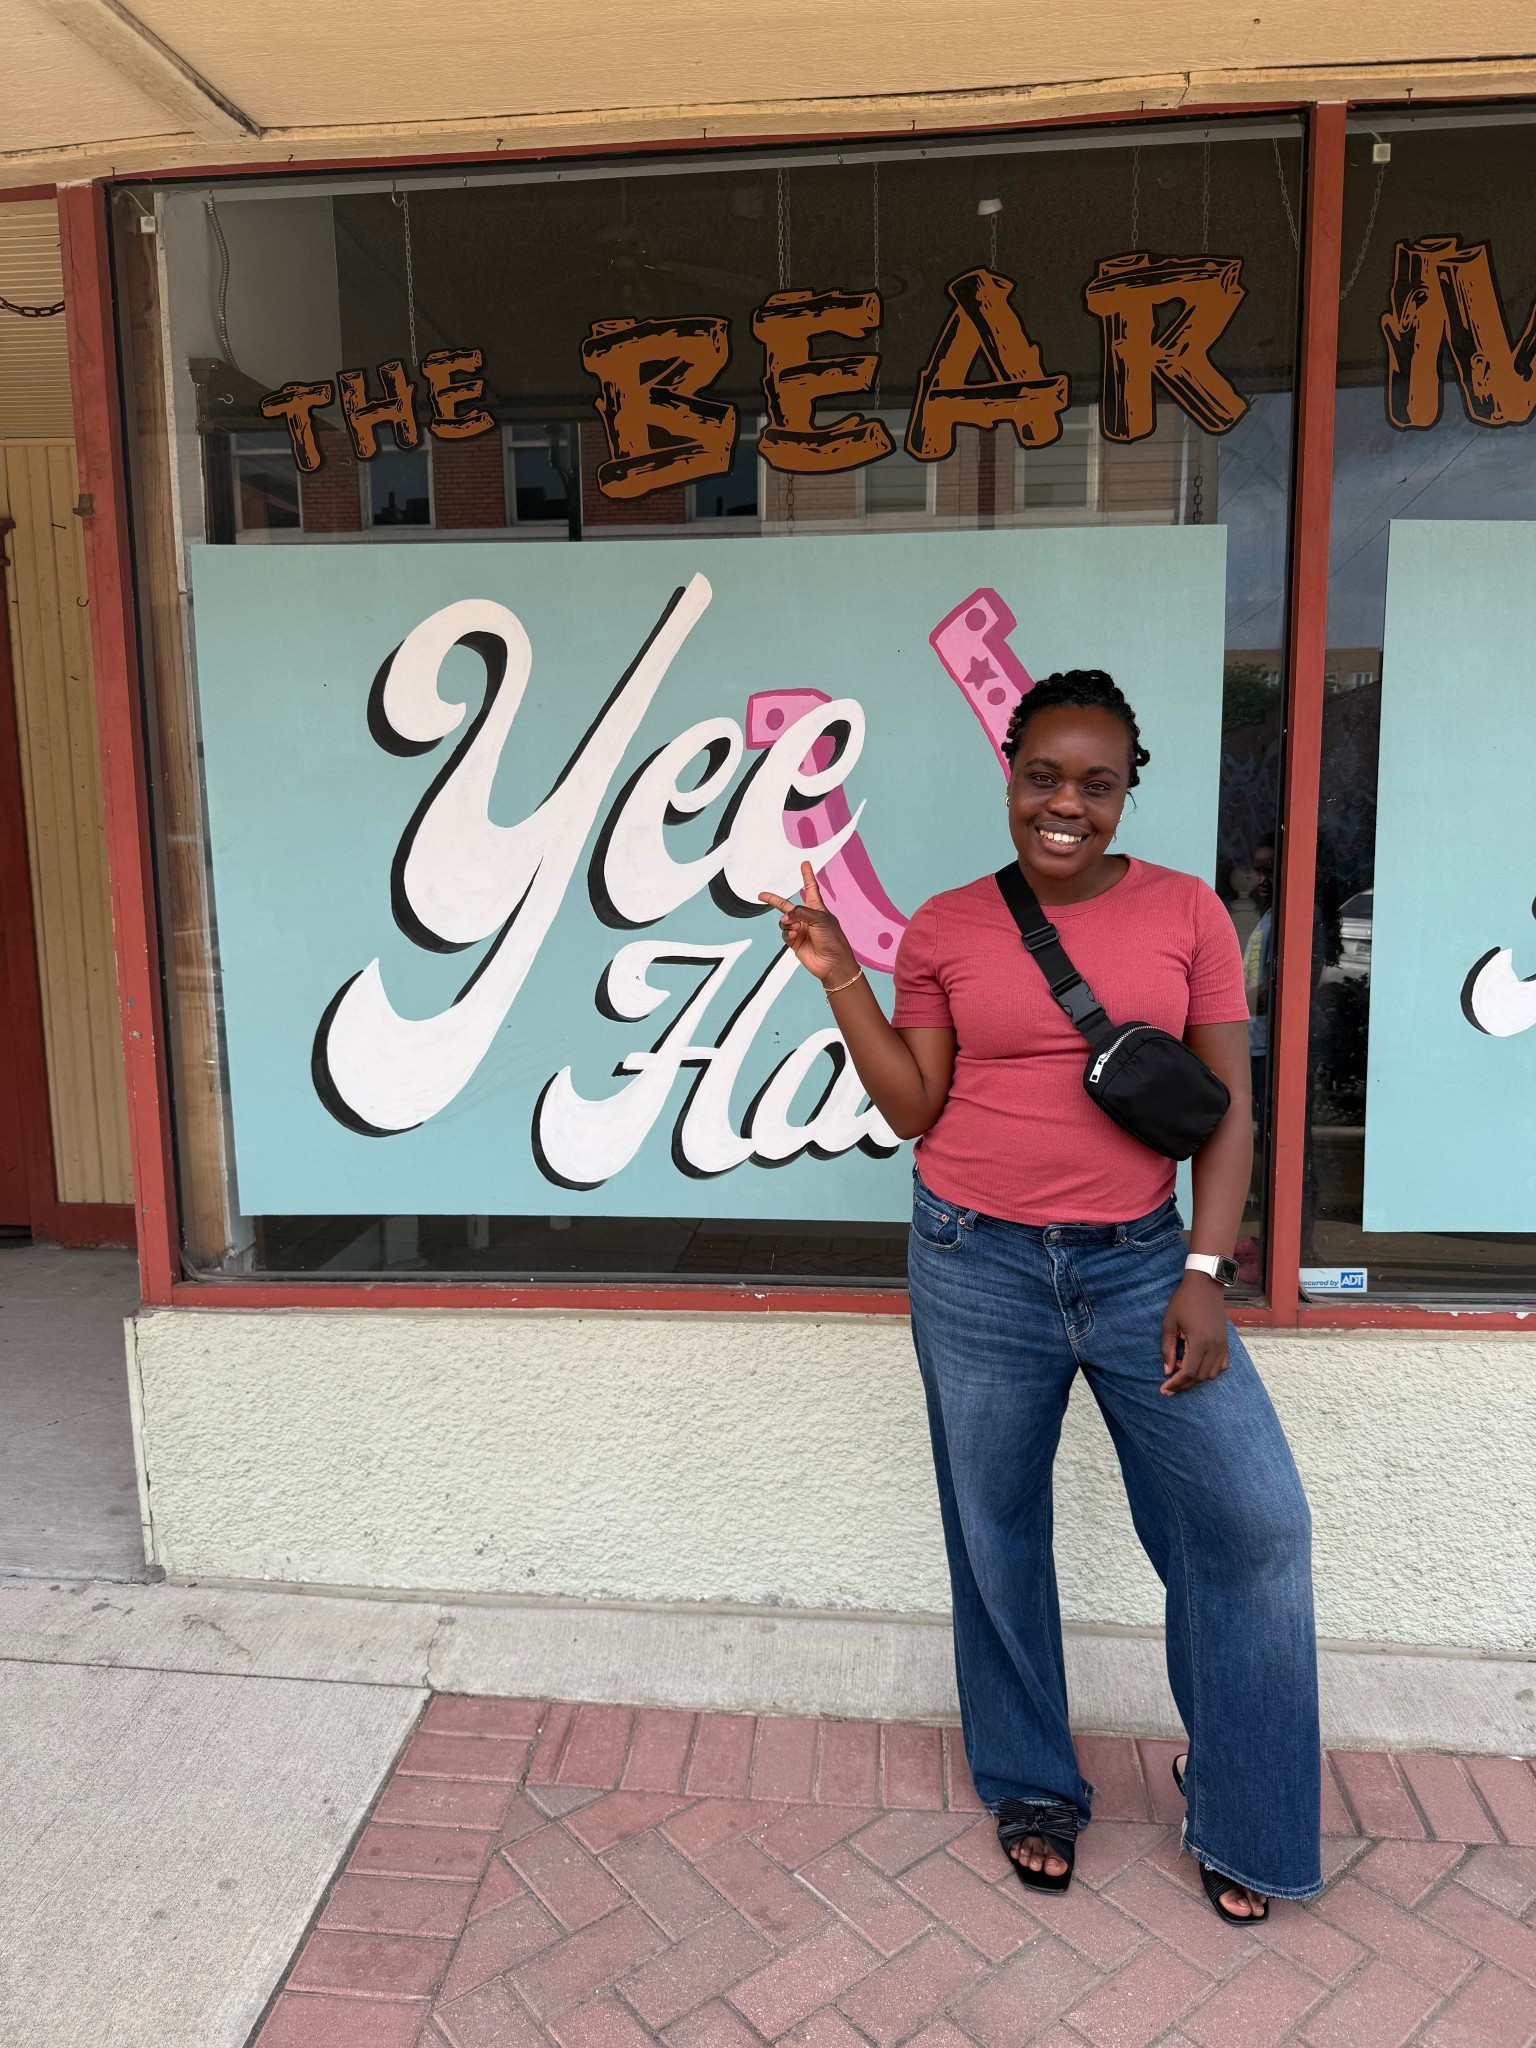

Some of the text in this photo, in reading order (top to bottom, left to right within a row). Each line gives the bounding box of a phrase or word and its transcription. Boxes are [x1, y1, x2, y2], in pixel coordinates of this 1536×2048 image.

[259, 347, 496, 474] THE
[578, 249, 1252, 502] BEAR
[311, 571, 867, 1138] Yee
[531, 938, 921, 1192] Ha
[1329, 1279, 1340, 1288] by
[1341, 1274, 1364, 1287] ADT
